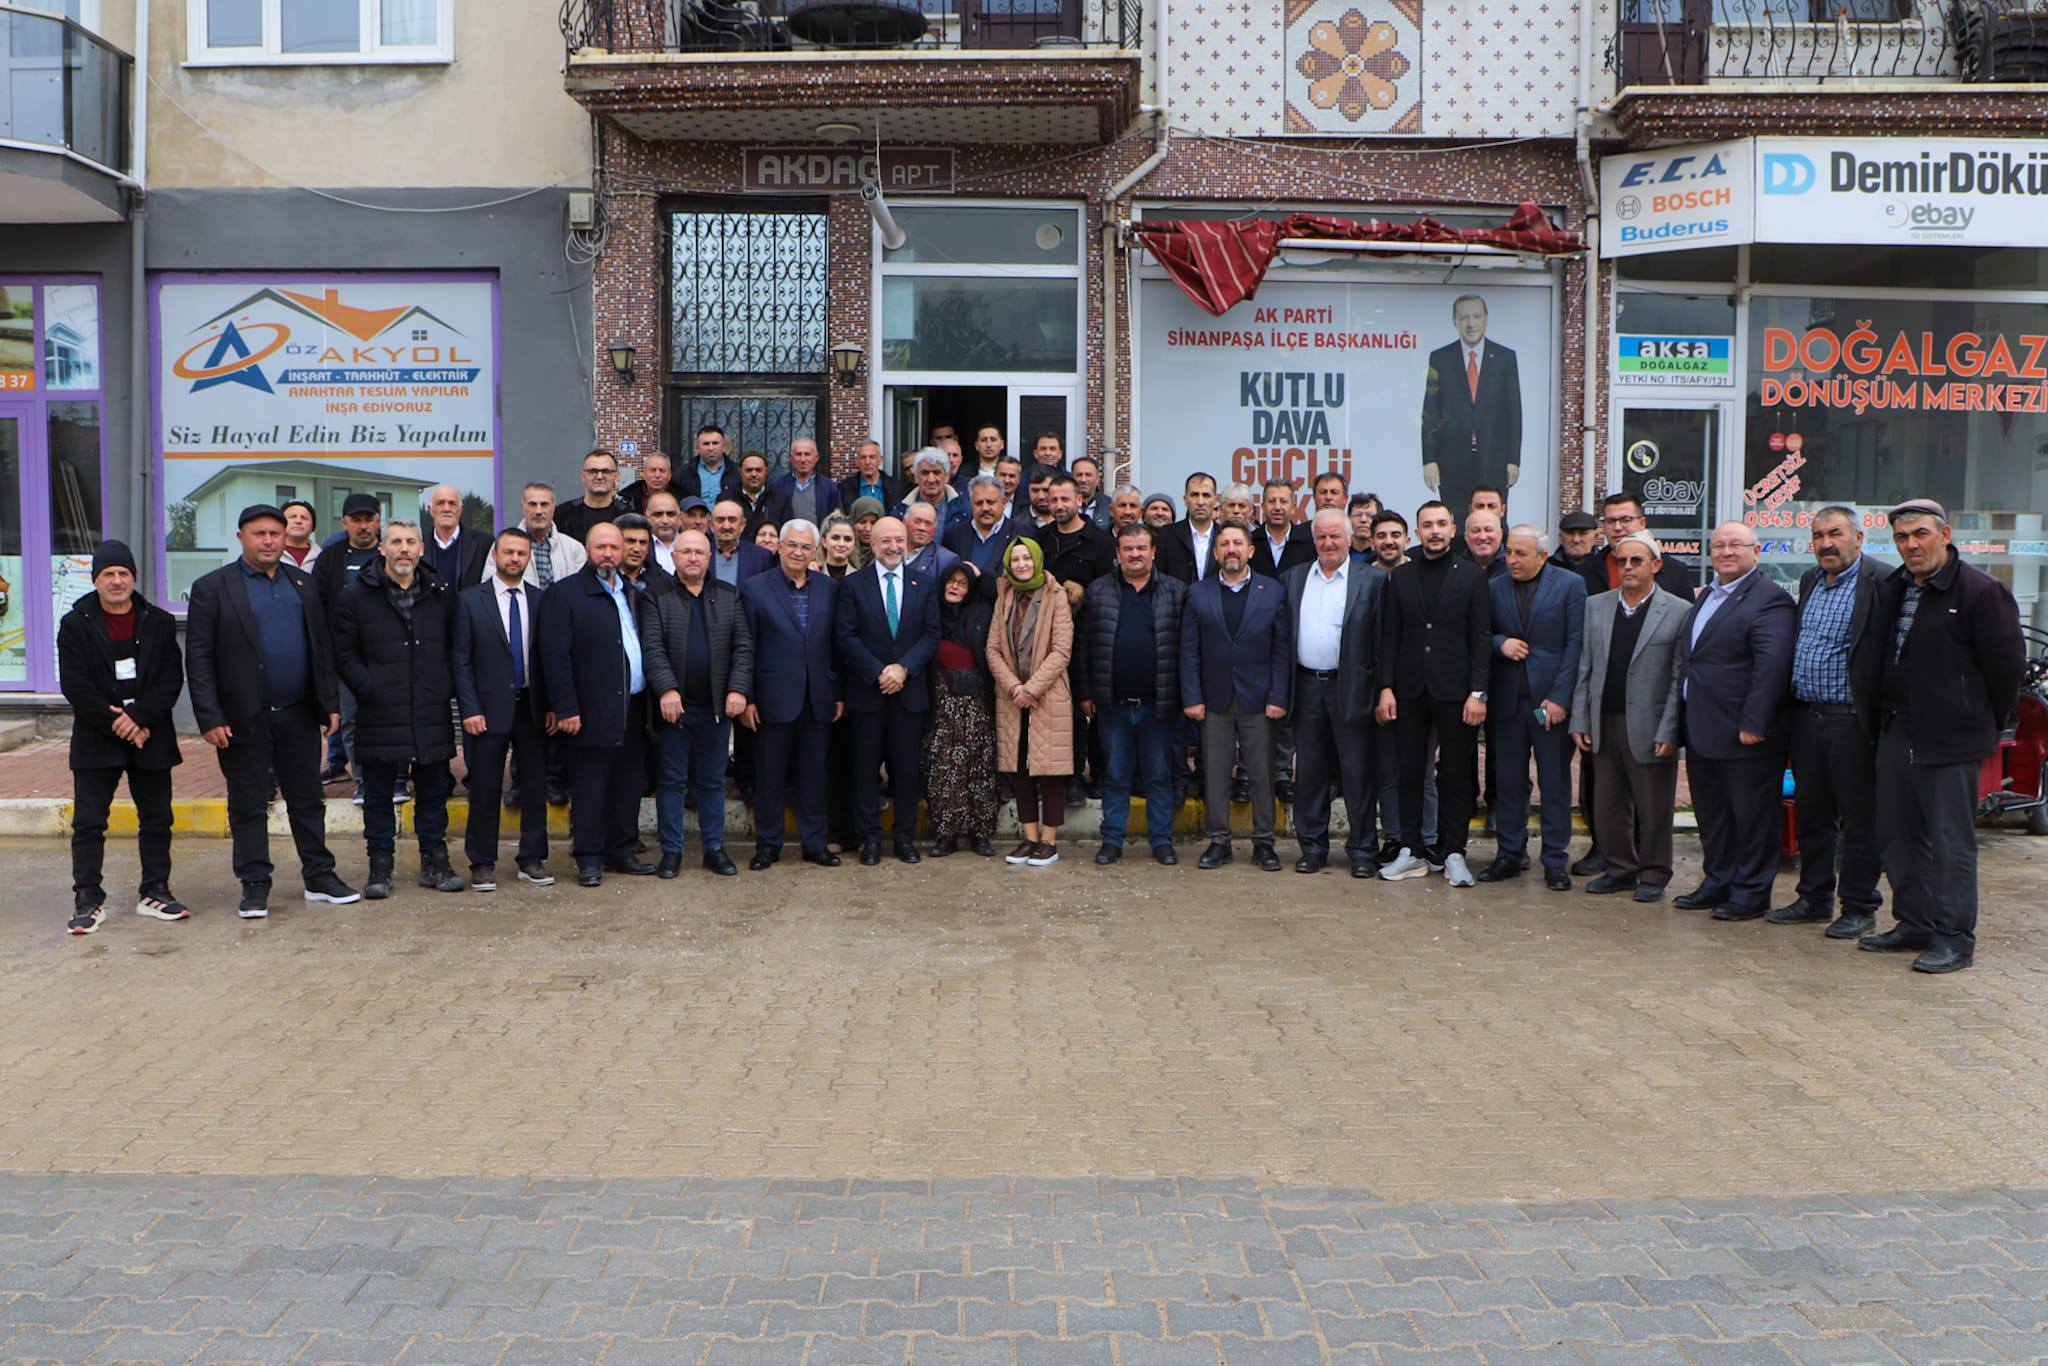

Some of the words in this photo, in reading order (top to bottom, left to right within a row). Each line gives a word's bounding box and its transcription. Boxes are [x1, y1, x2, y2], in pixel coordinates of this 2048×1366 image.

[892, 165, 940, 185] APT
[1831, 151, 2048, 196] DemirDökü
[1652, 187, 1731, 213] BOSCH
[1910, 202, 1975, 230] ebay
[1621, 219, 1729, 242] Buderus
[1254, 308, 1278, 324] AK
[1284, 305, 1333, 324] PARTİ
[1167, 327, 1265, 351] SİNANPAŞA
[1271, 328, 1308, 351] İLÇE
[1314, 330, 1417, 352] BAŞKANLIĞI
[1639, 340, 1709, 358] aksa
[1763, 319, 2048, 378] DOĞALGAZ
[286, 342, 319, 355] ÖZ
[318, 346, 472, 363] AKYOL
[288, 369, 333, 383] İNŞAAT
[345, 368, 400, 381] TAAHHÜT
[412, 368, 469, 381] ELEKTRİK
[1640, 360, 1708, 370] DOĞALGAZ
[10, 375, 27, 387] 37
[1240, 371, 1345, 408] KUTLU
[1618, 374, 1648, 383] YETKİ
[1651, 375, 1668, 384] NO:
[289, 386, 355, 397] ANAHTAR
[411, 386, 469, 397] YAPILAR
[1761, 373, 1917, 415] DÖNÜŞÜM
[1922, 379, 2048, 413] MERKEZİ
[325, 402, 358, 416] İNŞA
[363, 401, 433, 413] EDİYORUZ
[168, 424, 202, 445] Siz
[211, 425, 279, 449] Hayal
[288, 425, 341, 444] Edin
[351, 424, 387, 443] Biz
[396, 423, 488, 448] Yapalım
[1252, 410, 1331, 445] DAVA
[1641, 476, 1707, 507] ebay
[1763, 474, 1801, 510] KEŞİF
[1744, 510, 1793, 528] 0543
[1658, 539, 1700, 554] ALGAZ
